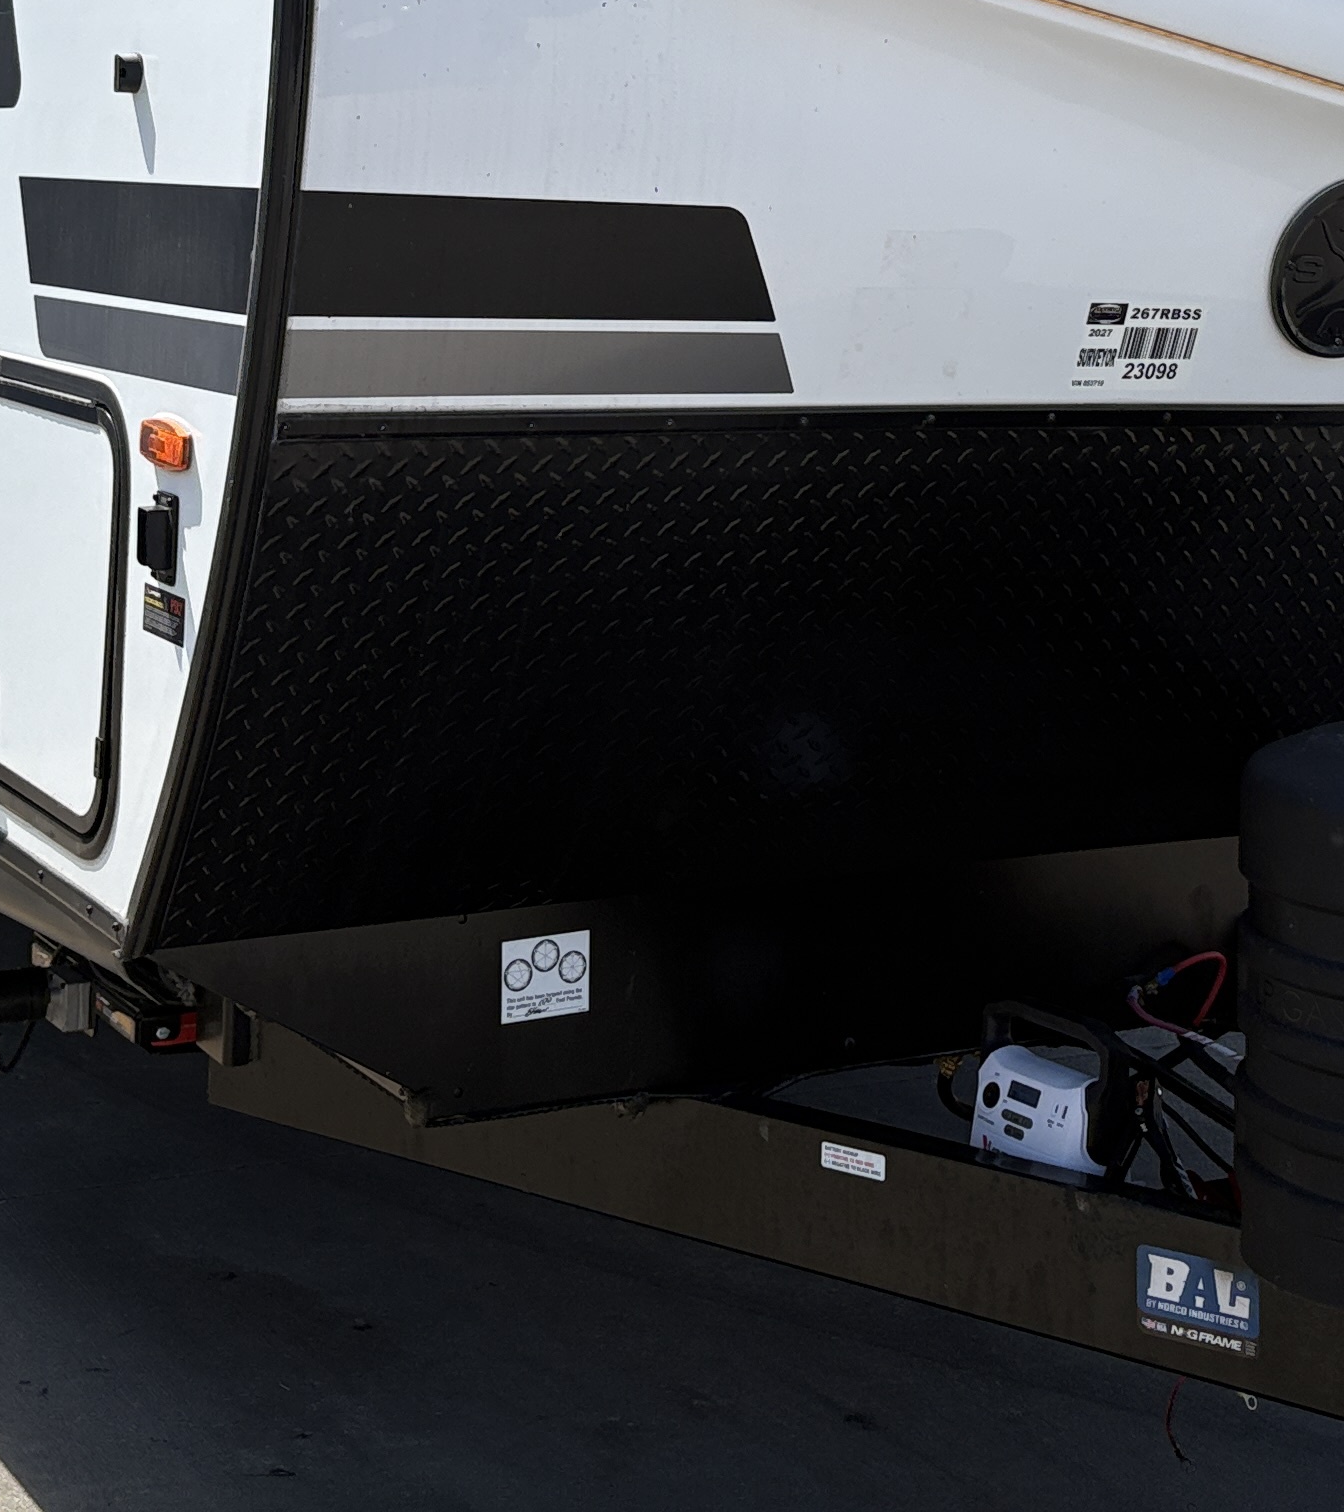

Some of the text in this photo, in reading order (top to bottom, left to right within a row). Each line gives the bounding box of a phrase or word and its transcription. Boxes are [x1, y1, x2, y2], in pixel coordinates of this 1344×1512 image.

[1130, 308, 1202, 320] 267RBSS
[1121, 363, 1178, 380] 23098
[1157, 1301, 1188, 1316] NORCO
[1188, 1309, 1240, 1330] INDUSTRIES
[1198, 1330, 1243, 1352] FRAME
